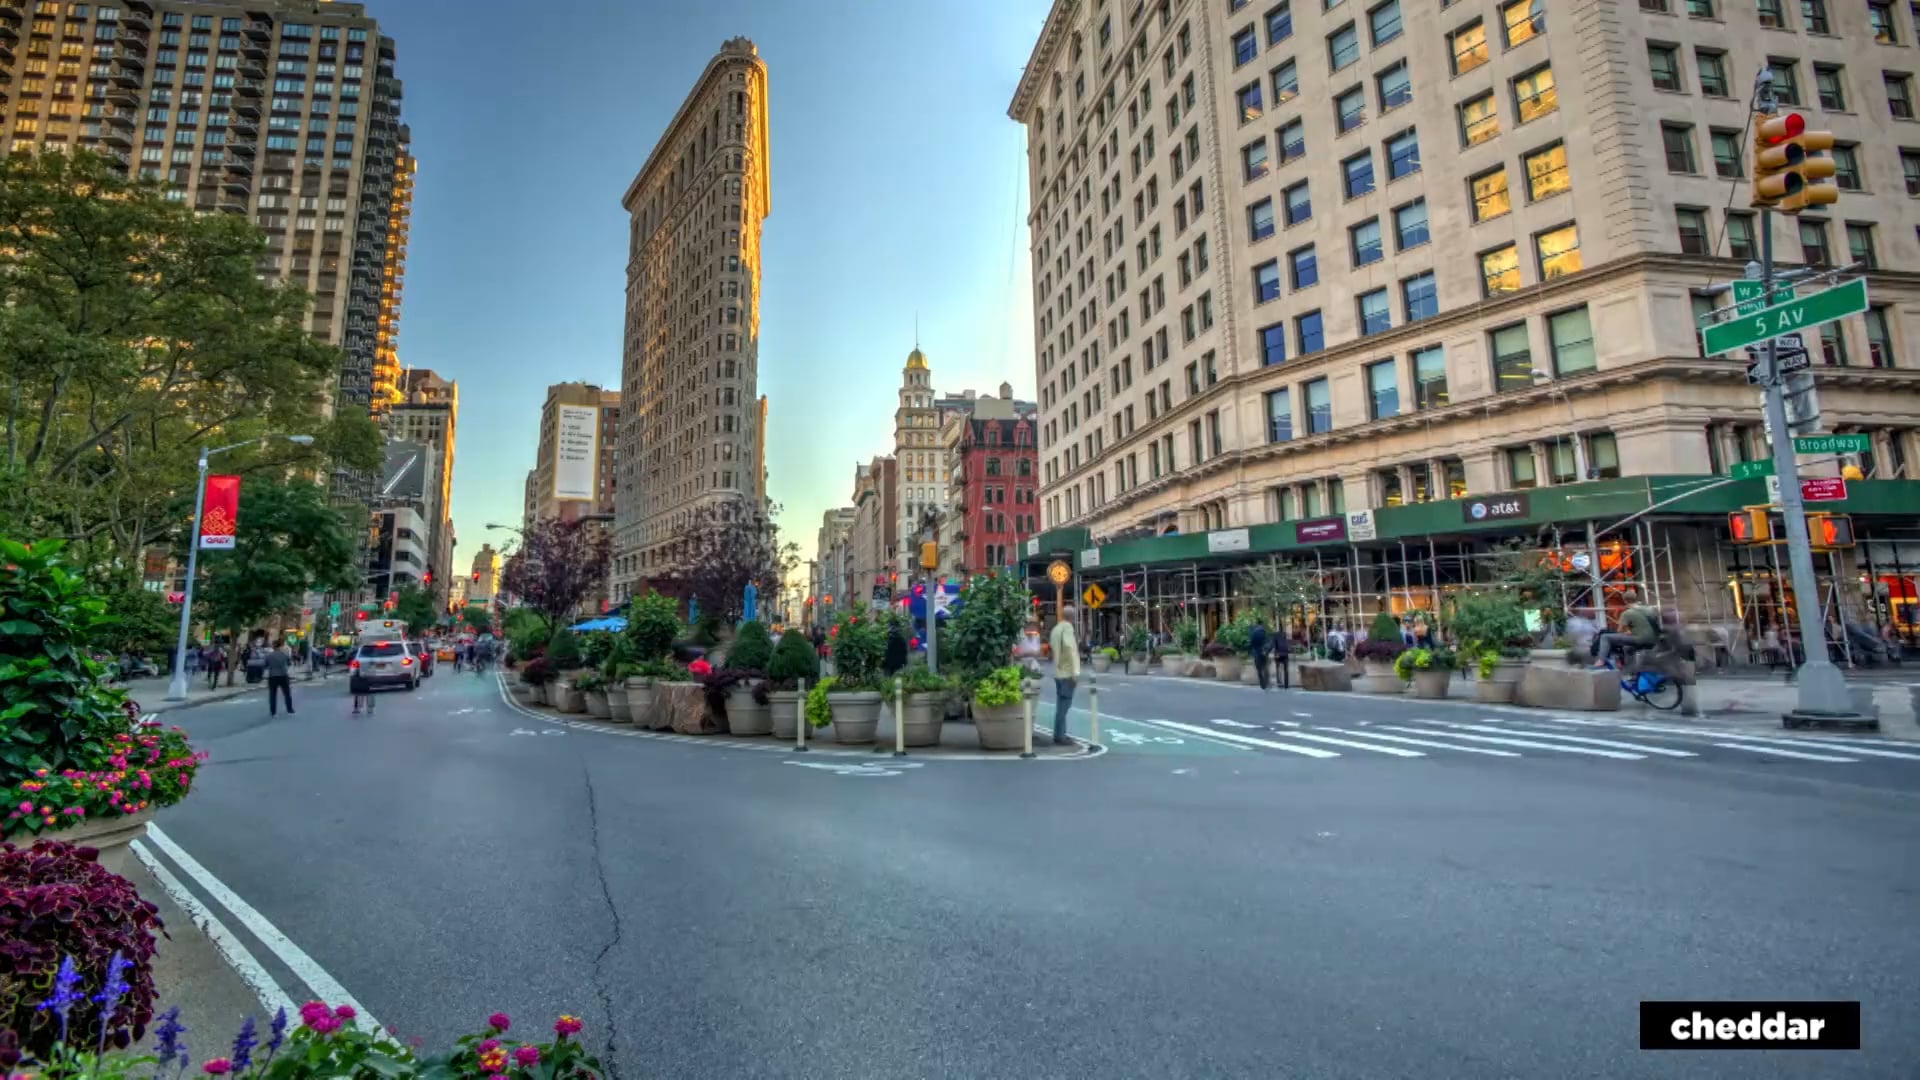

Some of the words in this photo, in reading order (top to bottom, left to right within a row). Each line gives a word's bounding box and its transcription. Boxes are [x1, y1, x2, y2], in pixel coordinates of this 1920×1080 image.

[1739, 287, 1750, 297] W
[1756, 317, 1767, 336] 5
[1778, 307, 1804, 330] AV
[1799, 437, 1861, 452] Broadway
[1490, 501, 1521, 515] at&t
